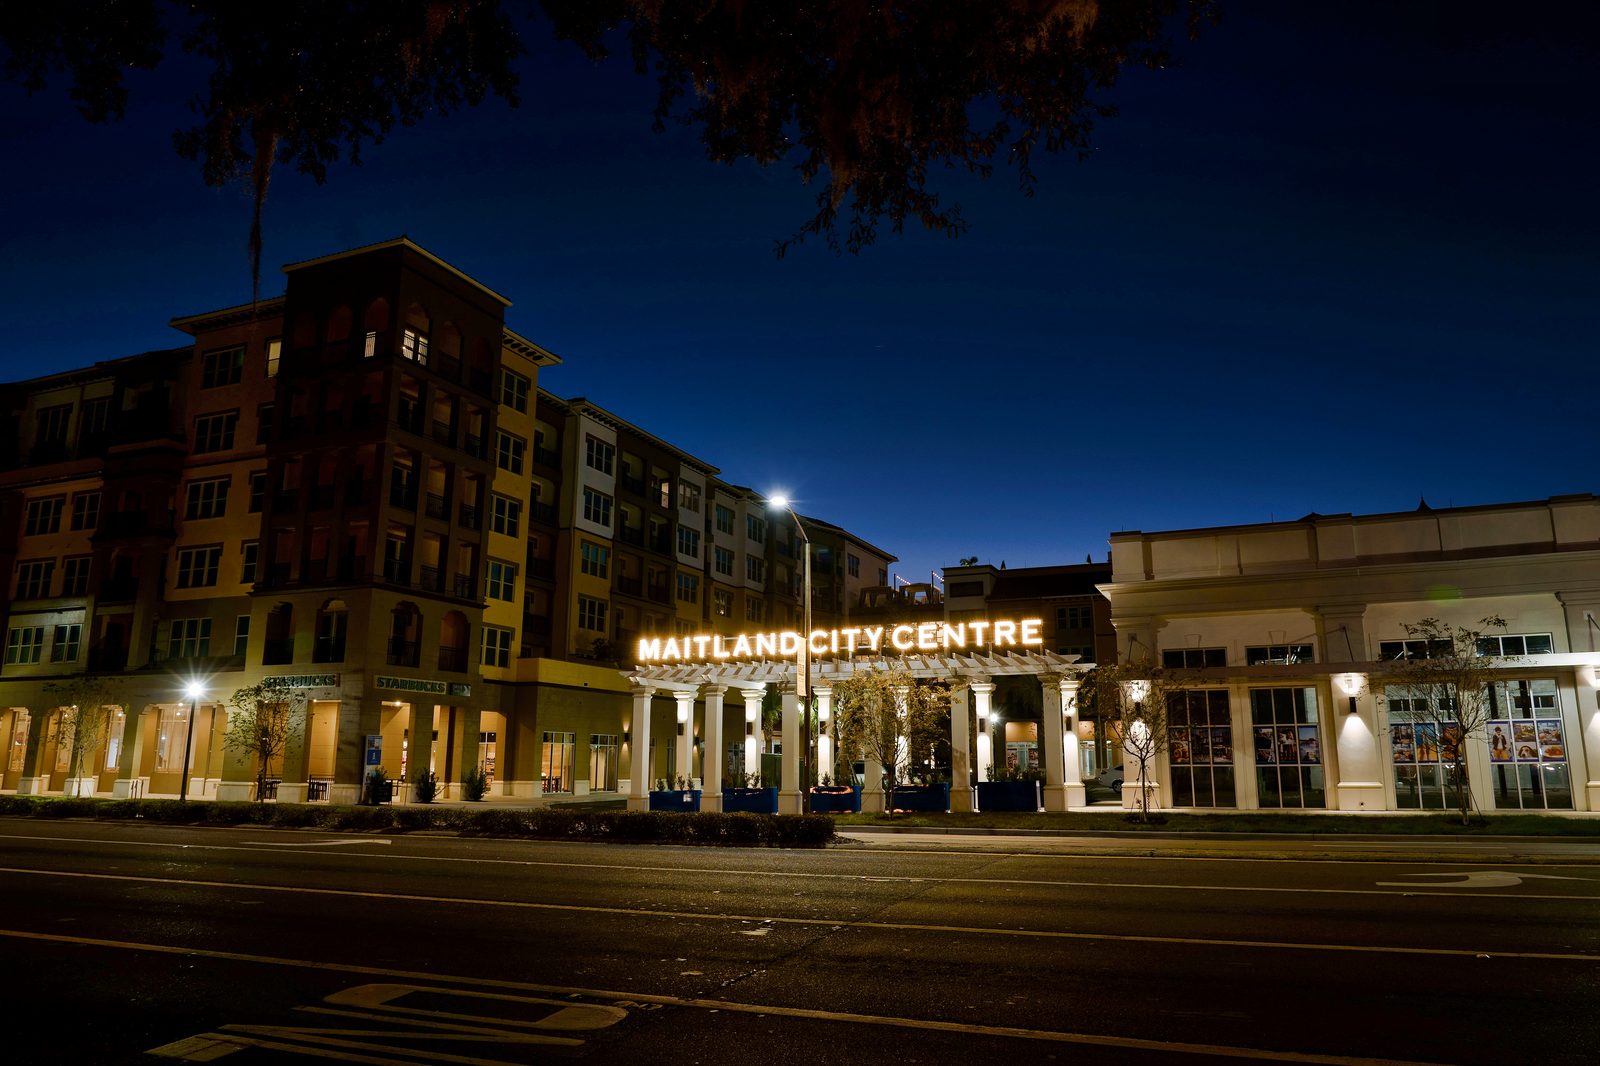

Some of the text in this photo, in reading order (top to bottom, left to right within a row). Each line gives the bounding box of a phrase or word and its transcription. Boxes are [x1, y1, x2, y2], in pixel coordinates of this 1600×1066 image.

[638, 619, 1044, 660] MAITLAND CITY CENTRE
[264, 675, 335, 687] STARBUCKS
[378, 677, 445, 693] STARBUCKS
